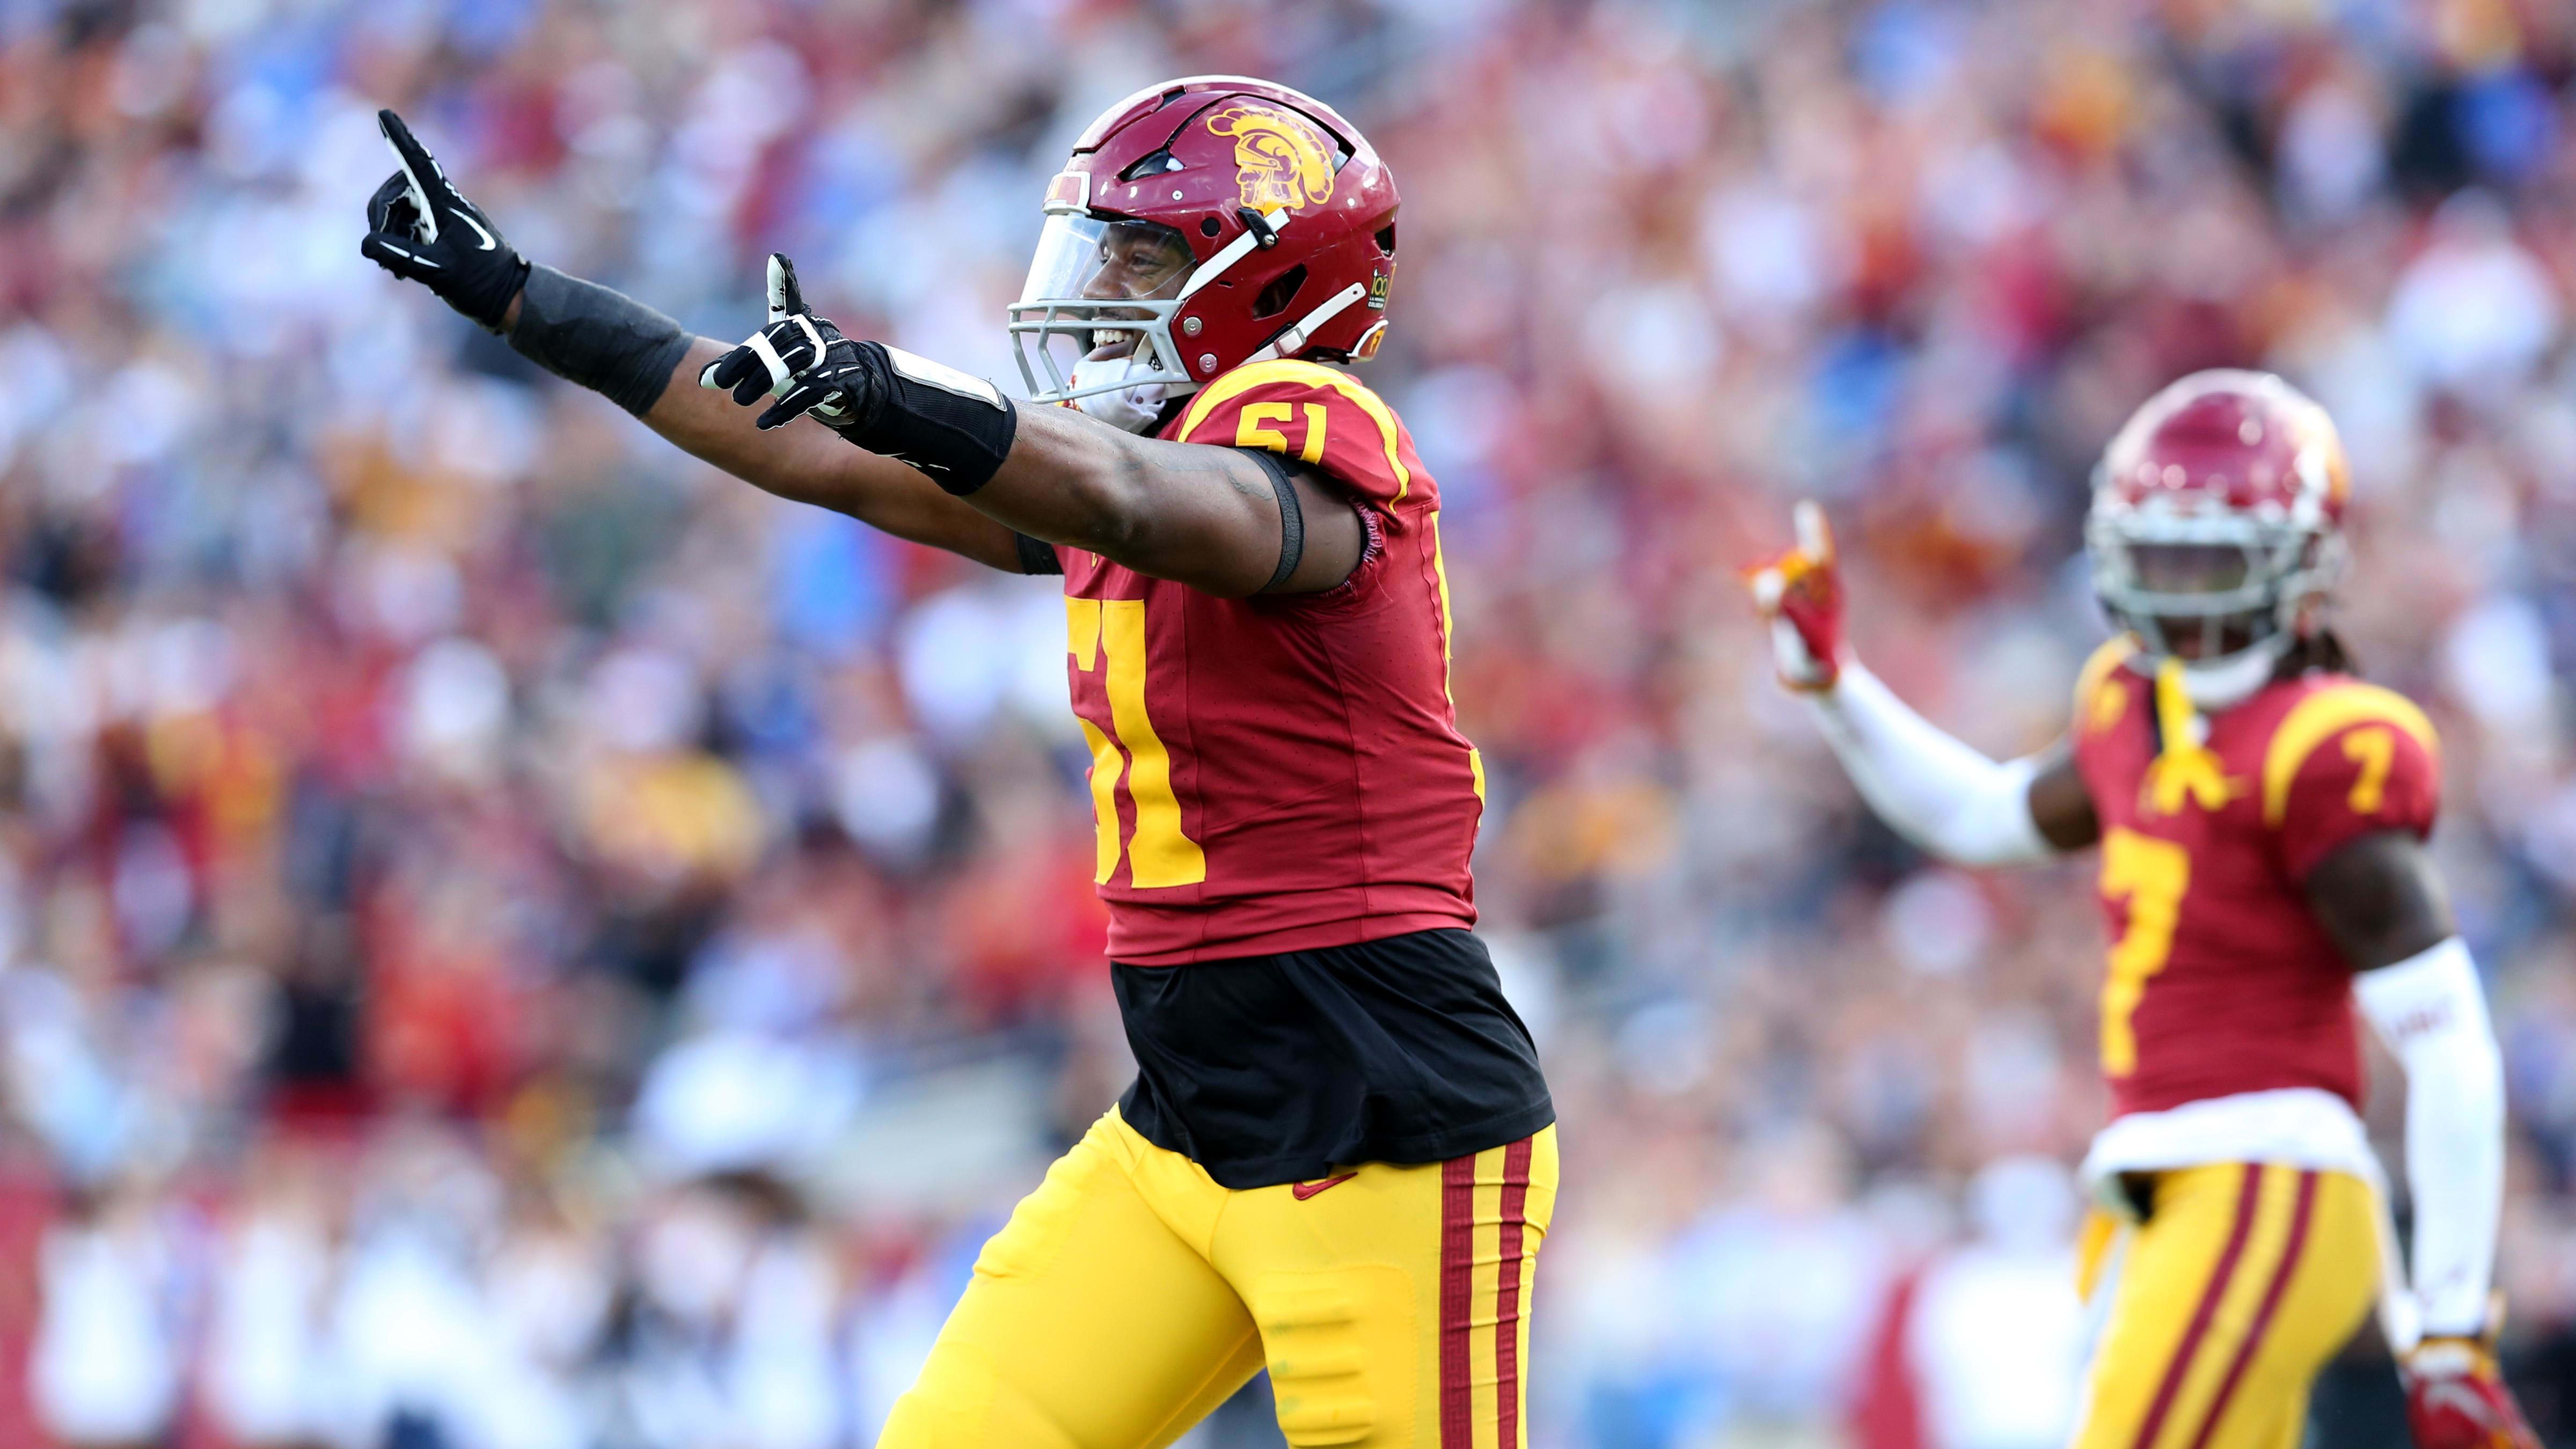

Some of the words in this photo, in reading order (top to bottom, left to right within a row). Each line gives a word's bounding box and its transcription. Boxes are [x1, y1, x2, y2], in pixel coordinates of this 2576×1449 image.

[1236, 402, 1327, 465] 51
[2341, 726, 2396, 815] 7
[2100, 826, 2191, 1079] 7
